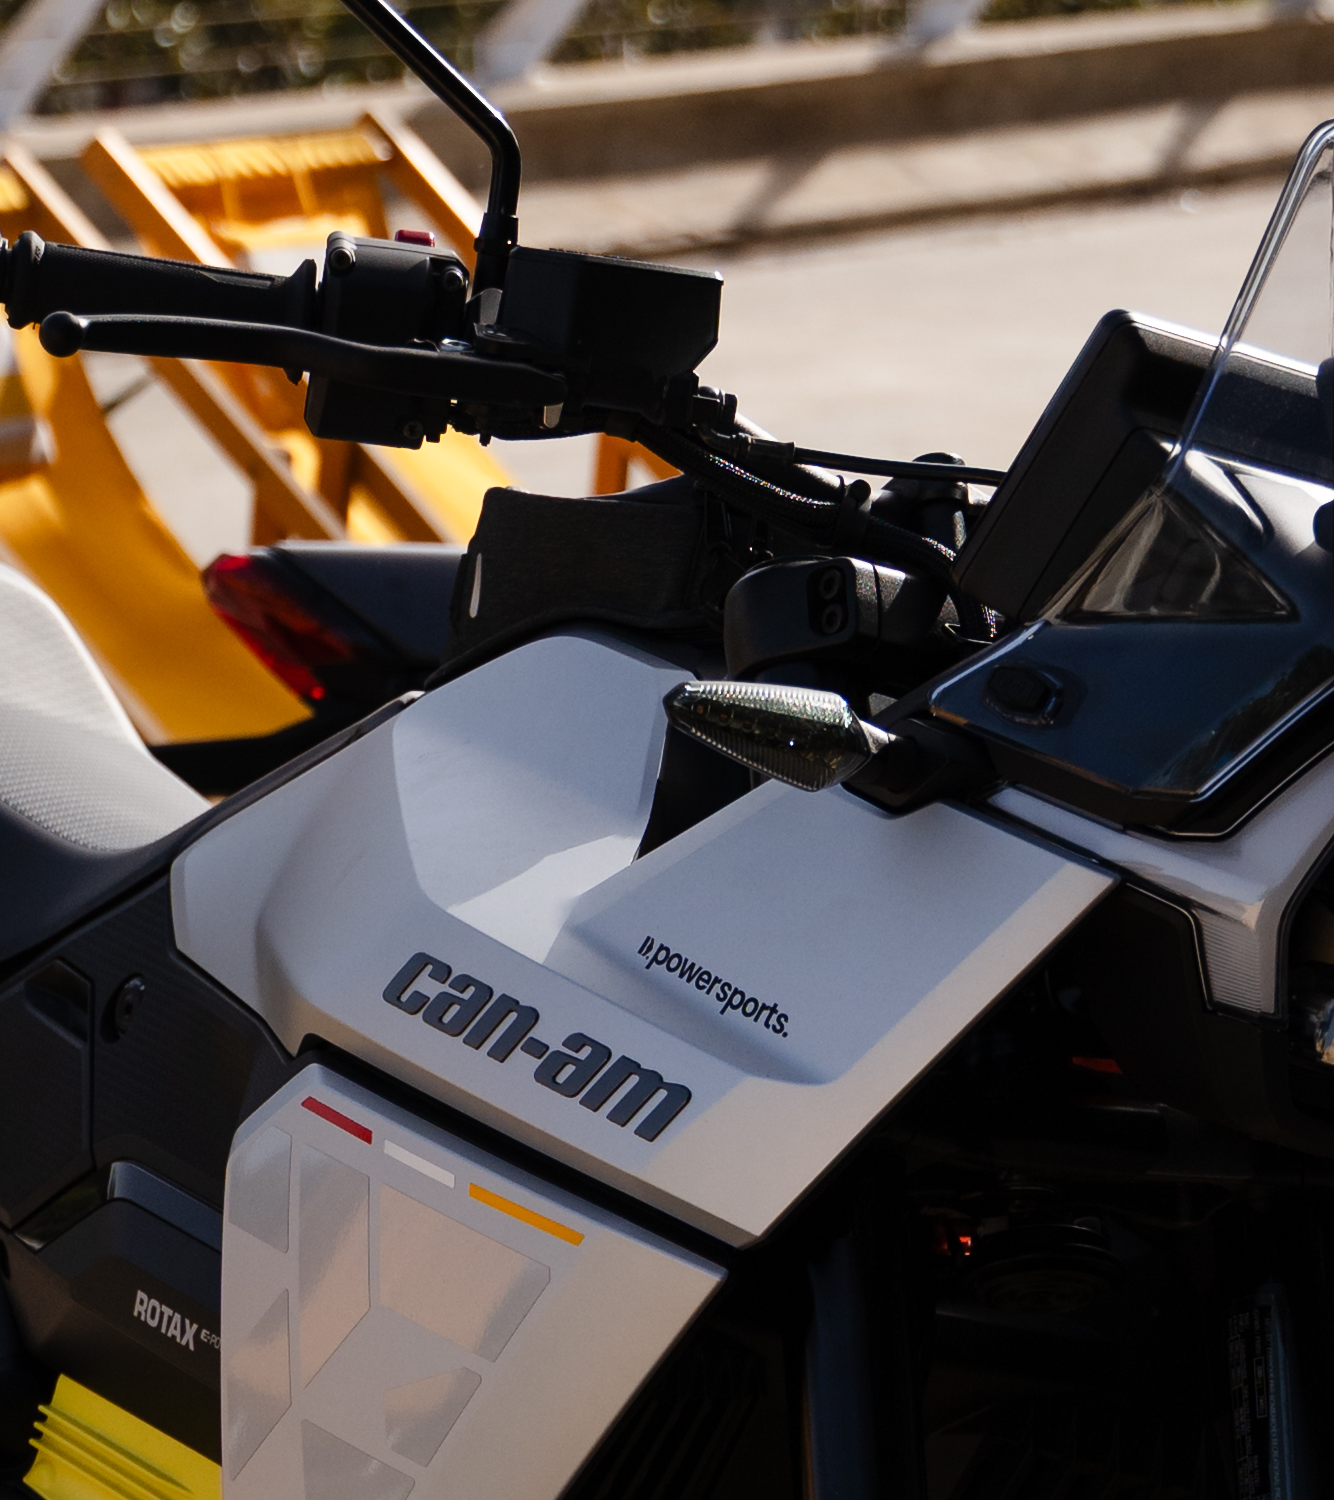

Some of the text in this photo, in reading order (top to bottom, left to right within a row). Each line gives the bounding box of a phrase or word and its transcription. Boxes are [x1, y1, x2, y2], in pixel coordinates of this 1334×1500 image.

[648, 941, 790, 1039] powersports.
[381, 951, 693, 1143] can-am
[132, 1289, 221, 1352] ROTAX E-PO
